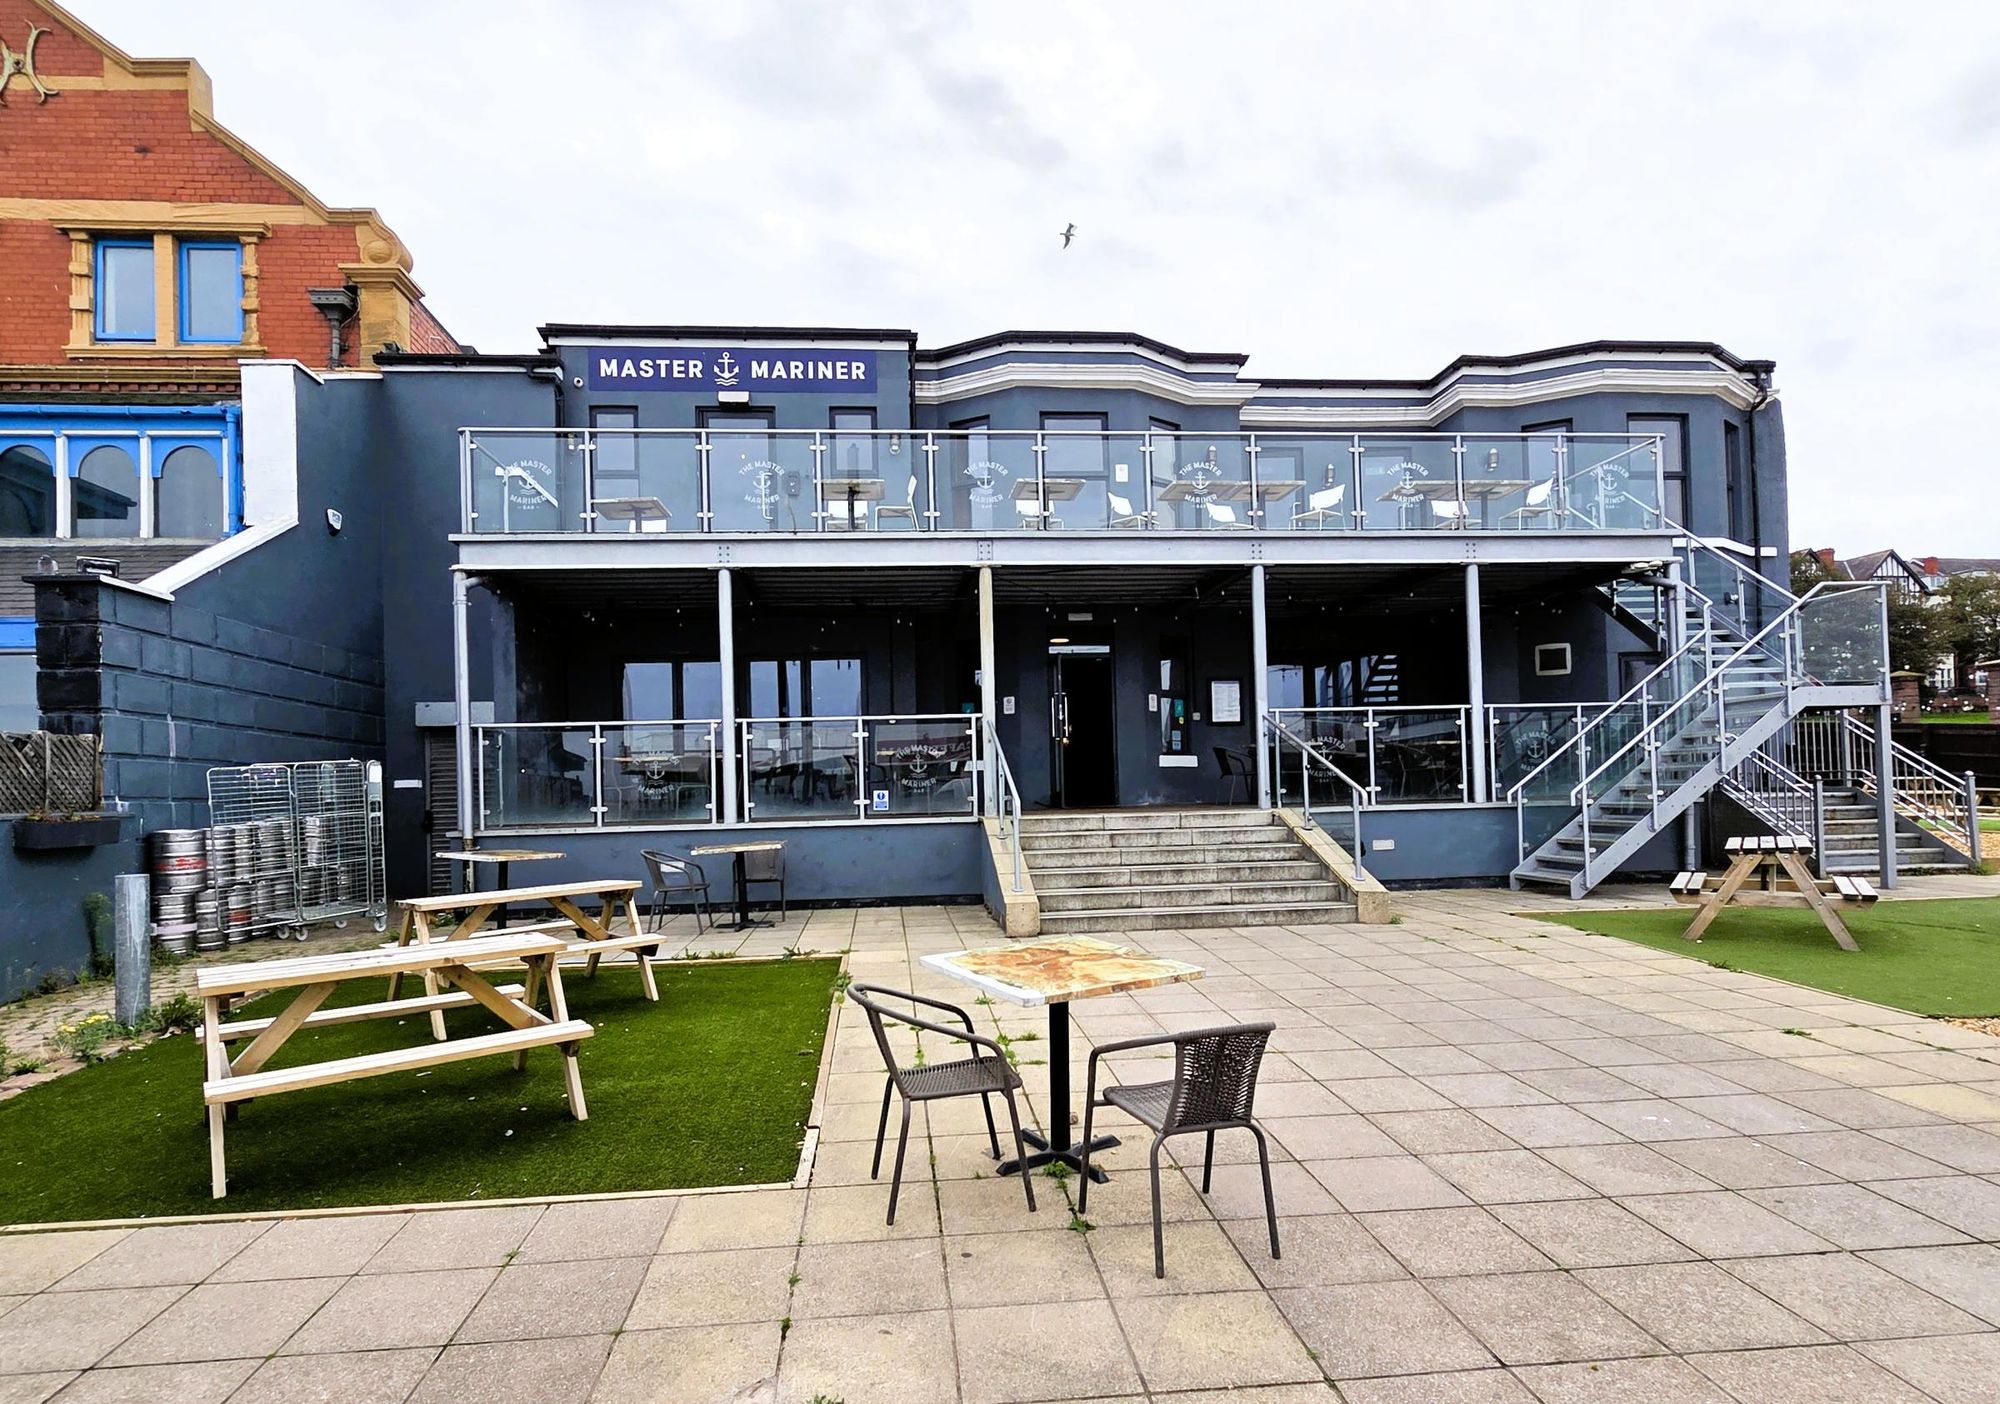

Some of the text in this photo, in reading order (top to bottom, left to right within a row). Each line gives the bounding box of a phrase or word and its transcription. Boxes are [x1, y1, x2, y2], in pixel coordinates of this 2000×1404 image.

[600, 358, 866, 380] MASTER MARINER
[520, 460, 553, 476] MASTER
[739, 460, 785, 476] THE MASTER
[963, 461, 1009, 477] THE MASTER
[1179, 461, 1222, 476] THE MASTER
[1386, 461, 1429, 477] THE MASTER
[1602, 463, 1630, 479] MASTER
[744, 494, 780, 504] MARNER
[969, 494, 1004, 504] MARINER
[1184, 493, 1218, 503] MARINER
[1391, 493, 1425, 503] MARINER
[1594, 495, 1626, 505] MRINER
[1317, 736, 1346, 750] MASTER
[896, 746, 911, 760] THE
[911, 744, 941, 760] MASTER
[1309, 768, 1338, 778] MARINE
[638, 784, 674, 795] MARINER
[902, 777, 937, 788] MARINER
